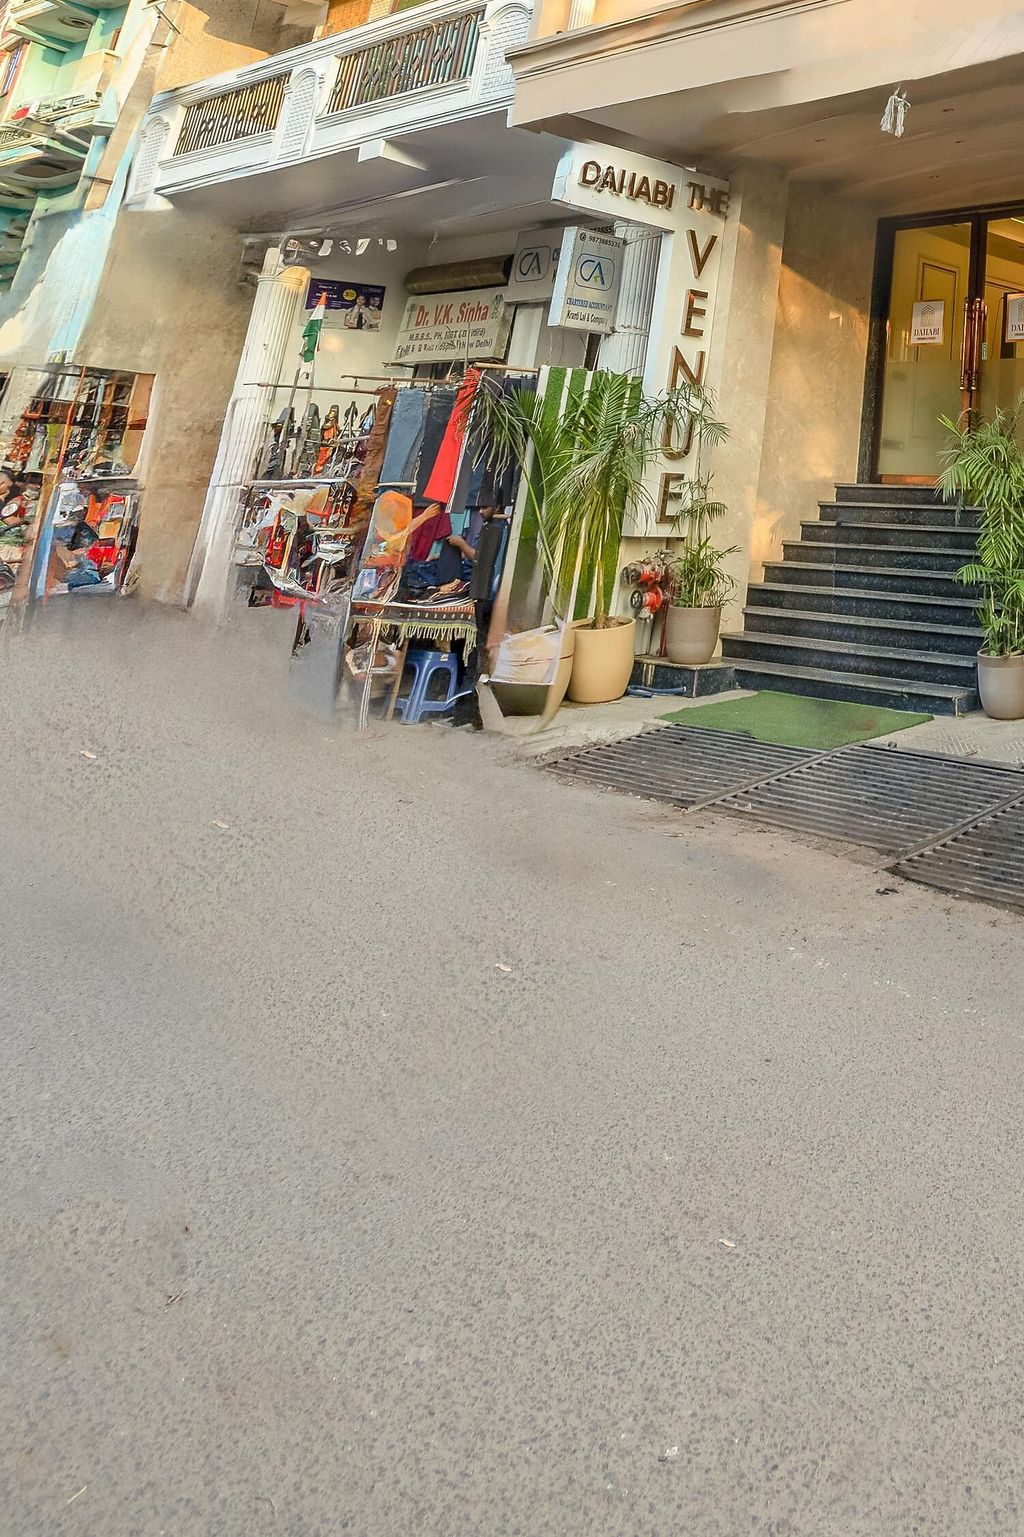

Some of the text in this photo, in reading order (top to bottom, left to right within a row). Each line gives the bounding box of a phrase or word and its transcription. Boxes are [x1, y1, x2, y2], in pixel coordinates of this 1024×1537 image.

[687, 181, 729, 215] THE
[415, 301, 489, 327] Dr. V.K. Sinha
[914, 327, 940, 337] DAHABI
